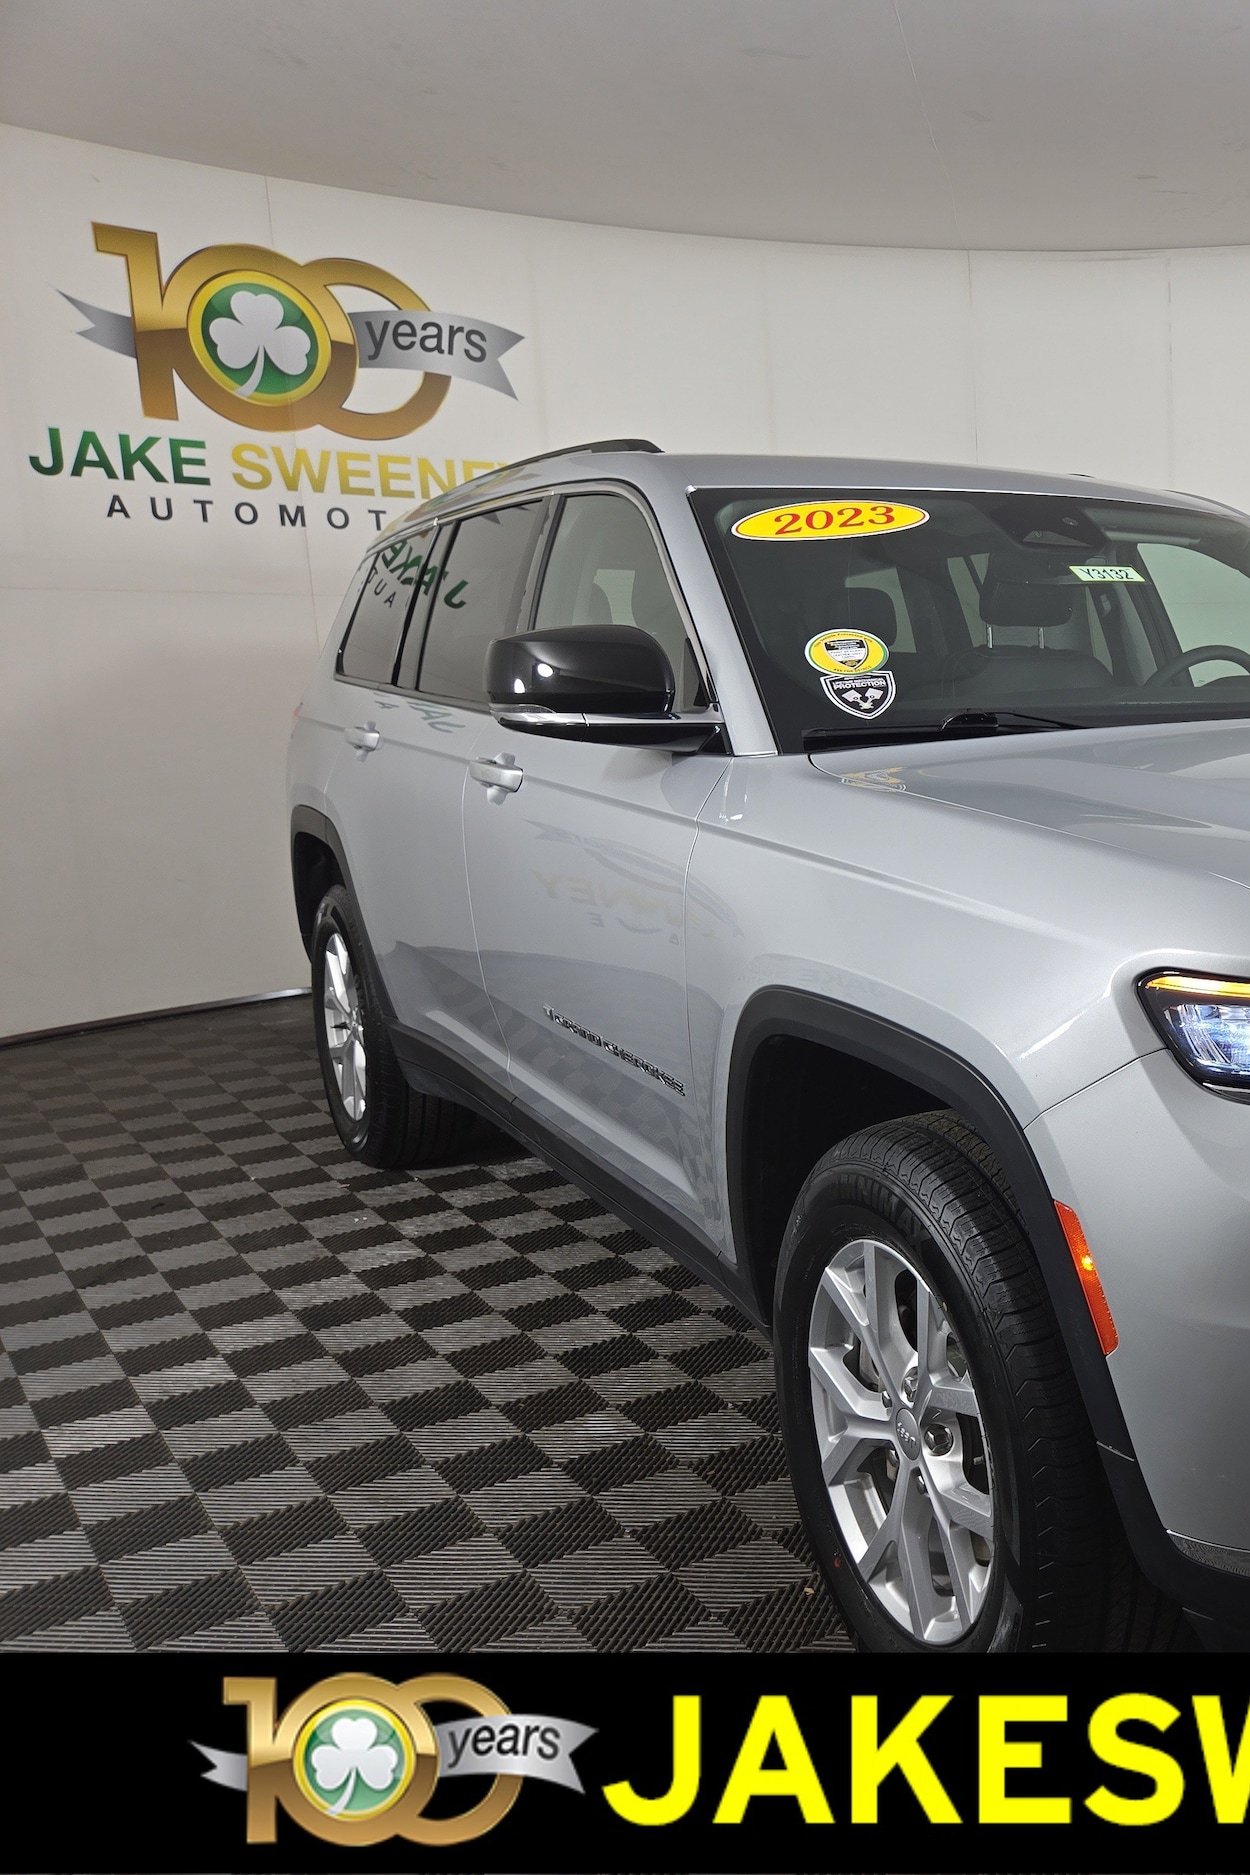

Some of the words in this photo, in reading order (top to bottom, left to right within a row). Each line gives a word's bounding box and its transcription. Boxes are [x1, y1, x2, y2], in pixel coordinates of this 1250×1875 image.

[364, 317, 488, 363] years
[28, 427, 211, 486] JAKE
[231, 443, 507, 499] SWEEN
[107, 494, 387, 531] AUTOMOT
[774, 506, 895, 535] 2023
[1080, 568, 1134, 580] Y3132
[834, 680, 887, 690] PROTECTION
